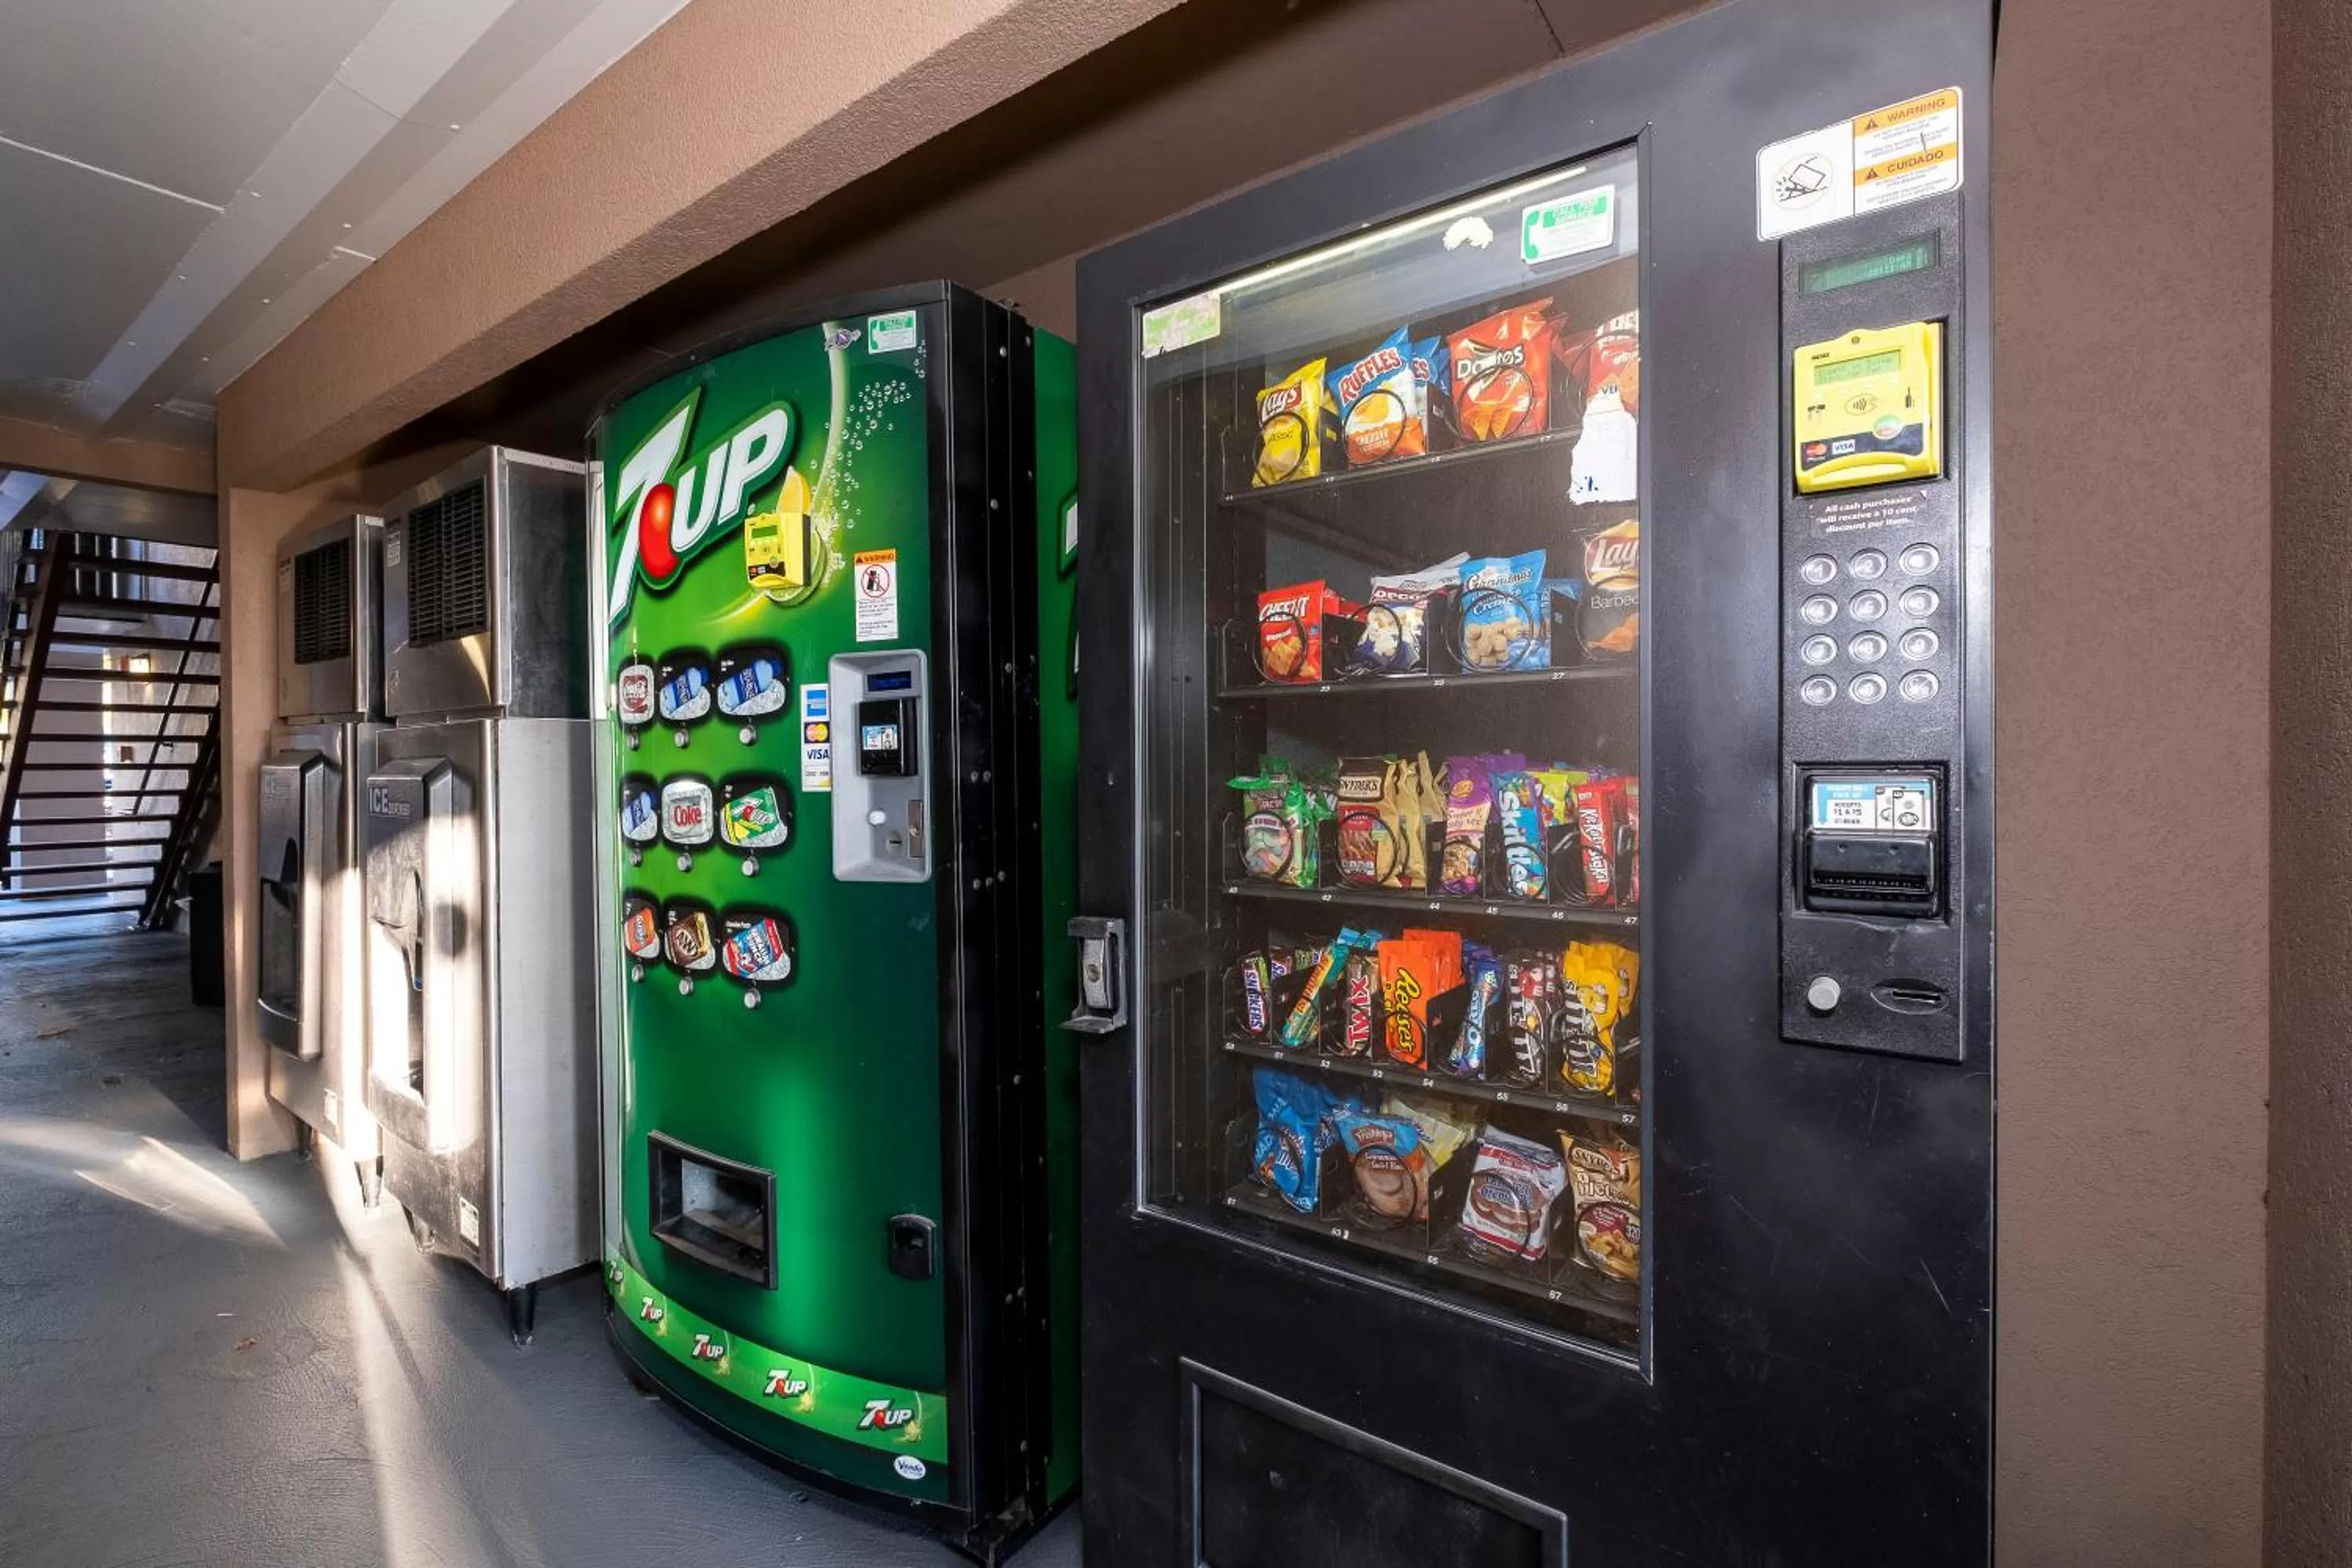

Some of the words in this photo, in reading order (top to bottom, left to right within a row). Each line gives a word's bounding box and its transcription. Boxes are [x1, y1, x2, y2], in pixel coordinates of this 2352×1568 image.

[1887, 99, 1945, 122] WARNING
[1887, 151, 1944, 173] CUIDADO
[1340, 348, 1402, 405] RUFFLES
[1835, 442, 1853, 451] VISA
[1839, 502, 1860, 512] cash
[1838, 511, 1872, 521] receive
[1826, 521, 1866, 533] discount
[1591, 539, 1639, 572] Lay
[1591, 593, 1639, 611] Barbec
[1552, 672, 1566, 681] 27
[807, 749, 829, 760] VISA
[369, 787, 388, 813] ICE
[673, 804, 702, 827] Coke
[1429, 902, 1441, 910] 44
[1486, 906, 1499, 915] 45
[1552, 911, 1564, 920] 46
[1624, 916, 1638, 925] 47
[1622, 1113, 1636, 1123] 57
[1549, 1290, 1563, 1301] 67
[764, 1369, 808, 1398] 7UP
[859, 1399, 914, 1430] 7UP
